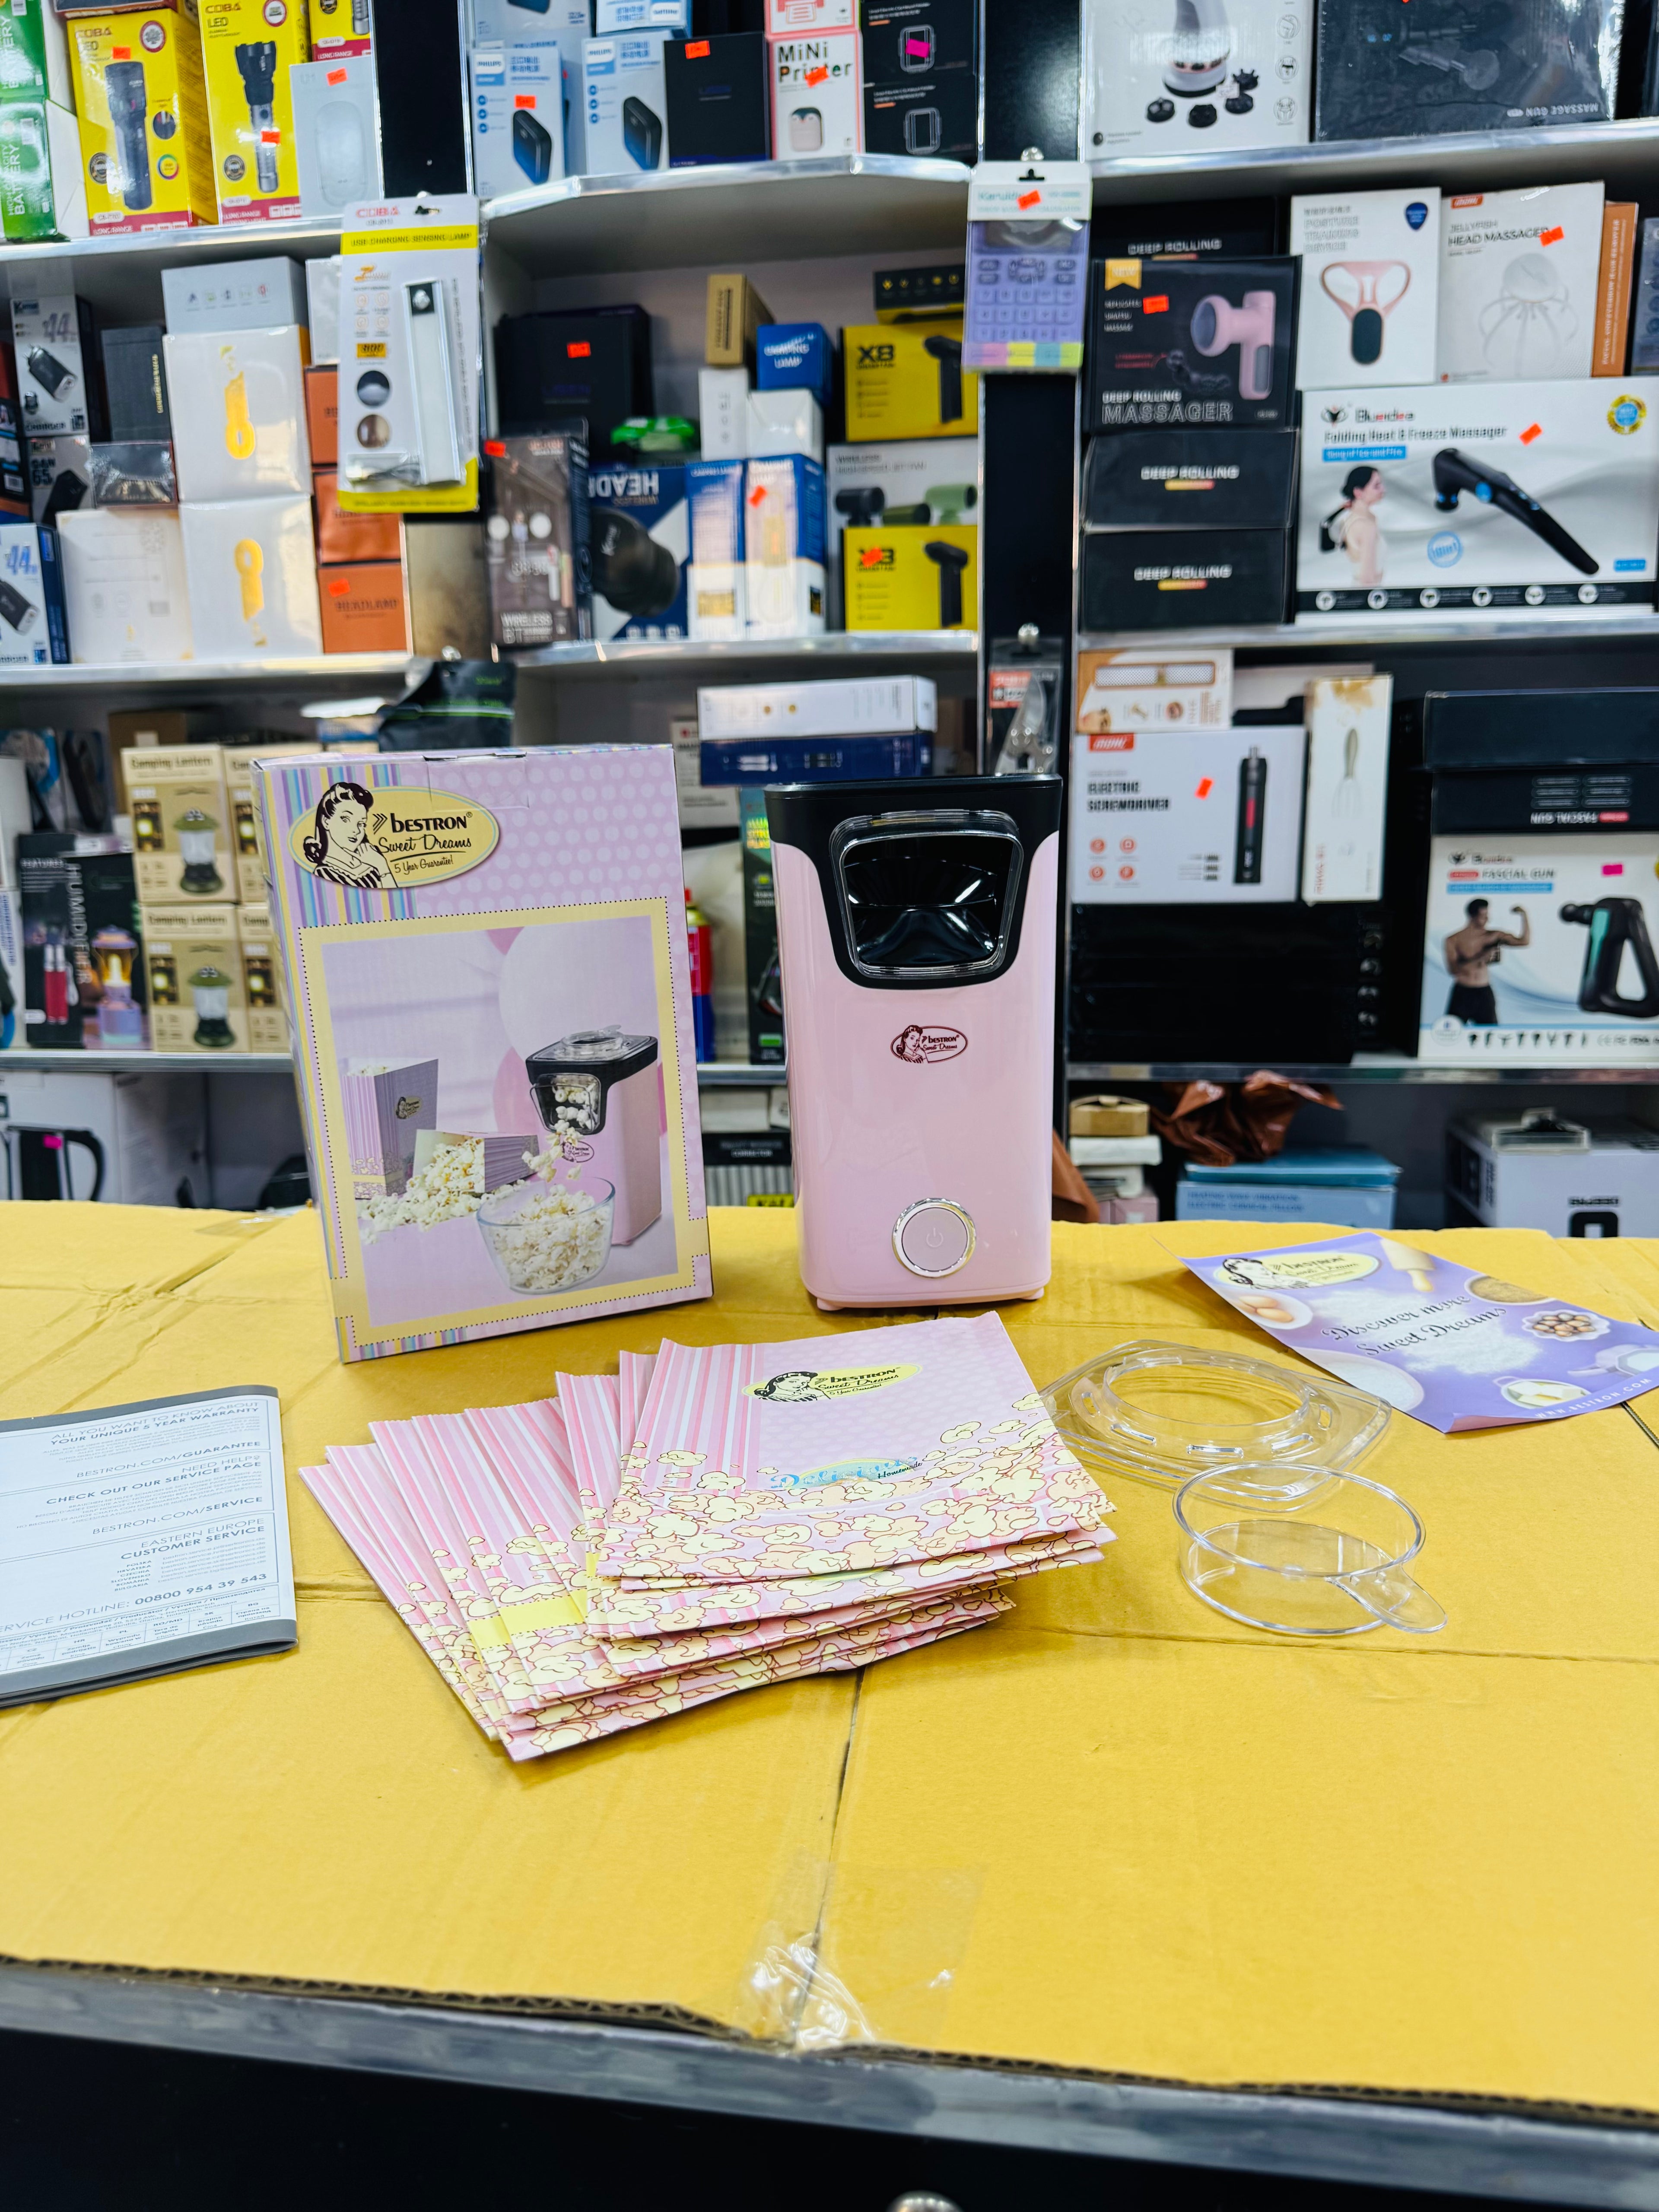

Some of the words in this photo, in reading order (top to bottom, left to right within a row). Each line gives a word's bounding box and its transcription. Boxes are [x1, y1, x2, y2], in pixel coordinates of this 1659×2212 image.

[207, 17, 229, 29] LED
[779, 41, 828, 62] MiNi
[1526, 107, 1548, 117] GUN
[1551, 103, 1598, 115] MASSAGE
[1128, 241, 1163, 254] DEEP
[1165, 238, 1222, 252] ROLLING
[1448, 235, 1482, 247] HEAD
[1103, 391, 1132, 403] DEEP
[1133, 391, 1182, 402] ROLLING
[1102, 401, 1233, 424] MASSAGER
[1449, 427, 1506, 440] Massager
[1141, 466, 1178, 480] DEEP
[1179, 465, 1239, 479] ROLLING
[1134, 567, 1171, 580] DEEP
[1172, 565, 1233, 579] ROLLING
[1088, 799, 1169, 811] SCREWDRIVER
[1531, 812, 1555, 824] GUN
[378, 836, 416, 853] Sweet
[423, 834, 471, 850] Dreams
[394, 864, 401, 873] 5
[403, 861, 419, 875] Year
[420, 854, 454, 869] Guarantee!
[1321, 1311, 1419, 1341] Discover
[1422, 1295, 1471, 1314] more
[1357, 1332, 1426, 1356] Sweet
[1421, 1307, 1506, 1338] Dreams
[857, 1375, 899, 1385] Dreams
[1535, 1378, 1652, 1418] WWW.BESTRON.COM
[111, 1418, 149, 1429] WANT
[172, 1408, 213, 1418] KNOW
[217, 1402, 259, 1410] ABOUT
[51, 1436, 86, 1445] YOUR
[91, 1427, 139, 1439] UNIQUE
[155, 1418, 186, 1427] YEAR
[191, 1408, 259, 1421] WARRANTY
[77, 1441, 261, 1478] BESTRON.COM/GUARANTEE
[183, 1462, 217, 1472] NEED
[222, 1456, 260, 1465] HELP?
[878, 1462, 923, 1479] Homemade
[46, 1492, 95, 1504] CHECK
[101, 1486, 128, 1495] OUT
[132, 1480, 161, 1489] OUR
[165, 1468, 219, 1483] SERVICE
[225, 1462, 261, 1471] PAGE
[93, 1497, 263, 1534] BESTRON.COM/SERVICE
[141, 1530, 202, 1548] EASTERN
[208, 1518, 264, 1534] EUROPE
[121, 1539, 201, 1560] CUSTOMER
[206, 1526, 265, 1542] SERVICE
[117, 1565, 151, 1573] HRVATSKA
[111, 1573, 151, 1583] SLOVENSKO
[114, 1583, 149, 1592] BULGARIA
[60, 1602, 130, 1621] HOTLINE:
[135, 1591, 181, 1605] 00800
[186, 1584, 213, 1594] 954
[241, 1573, 267, 1583] 543
